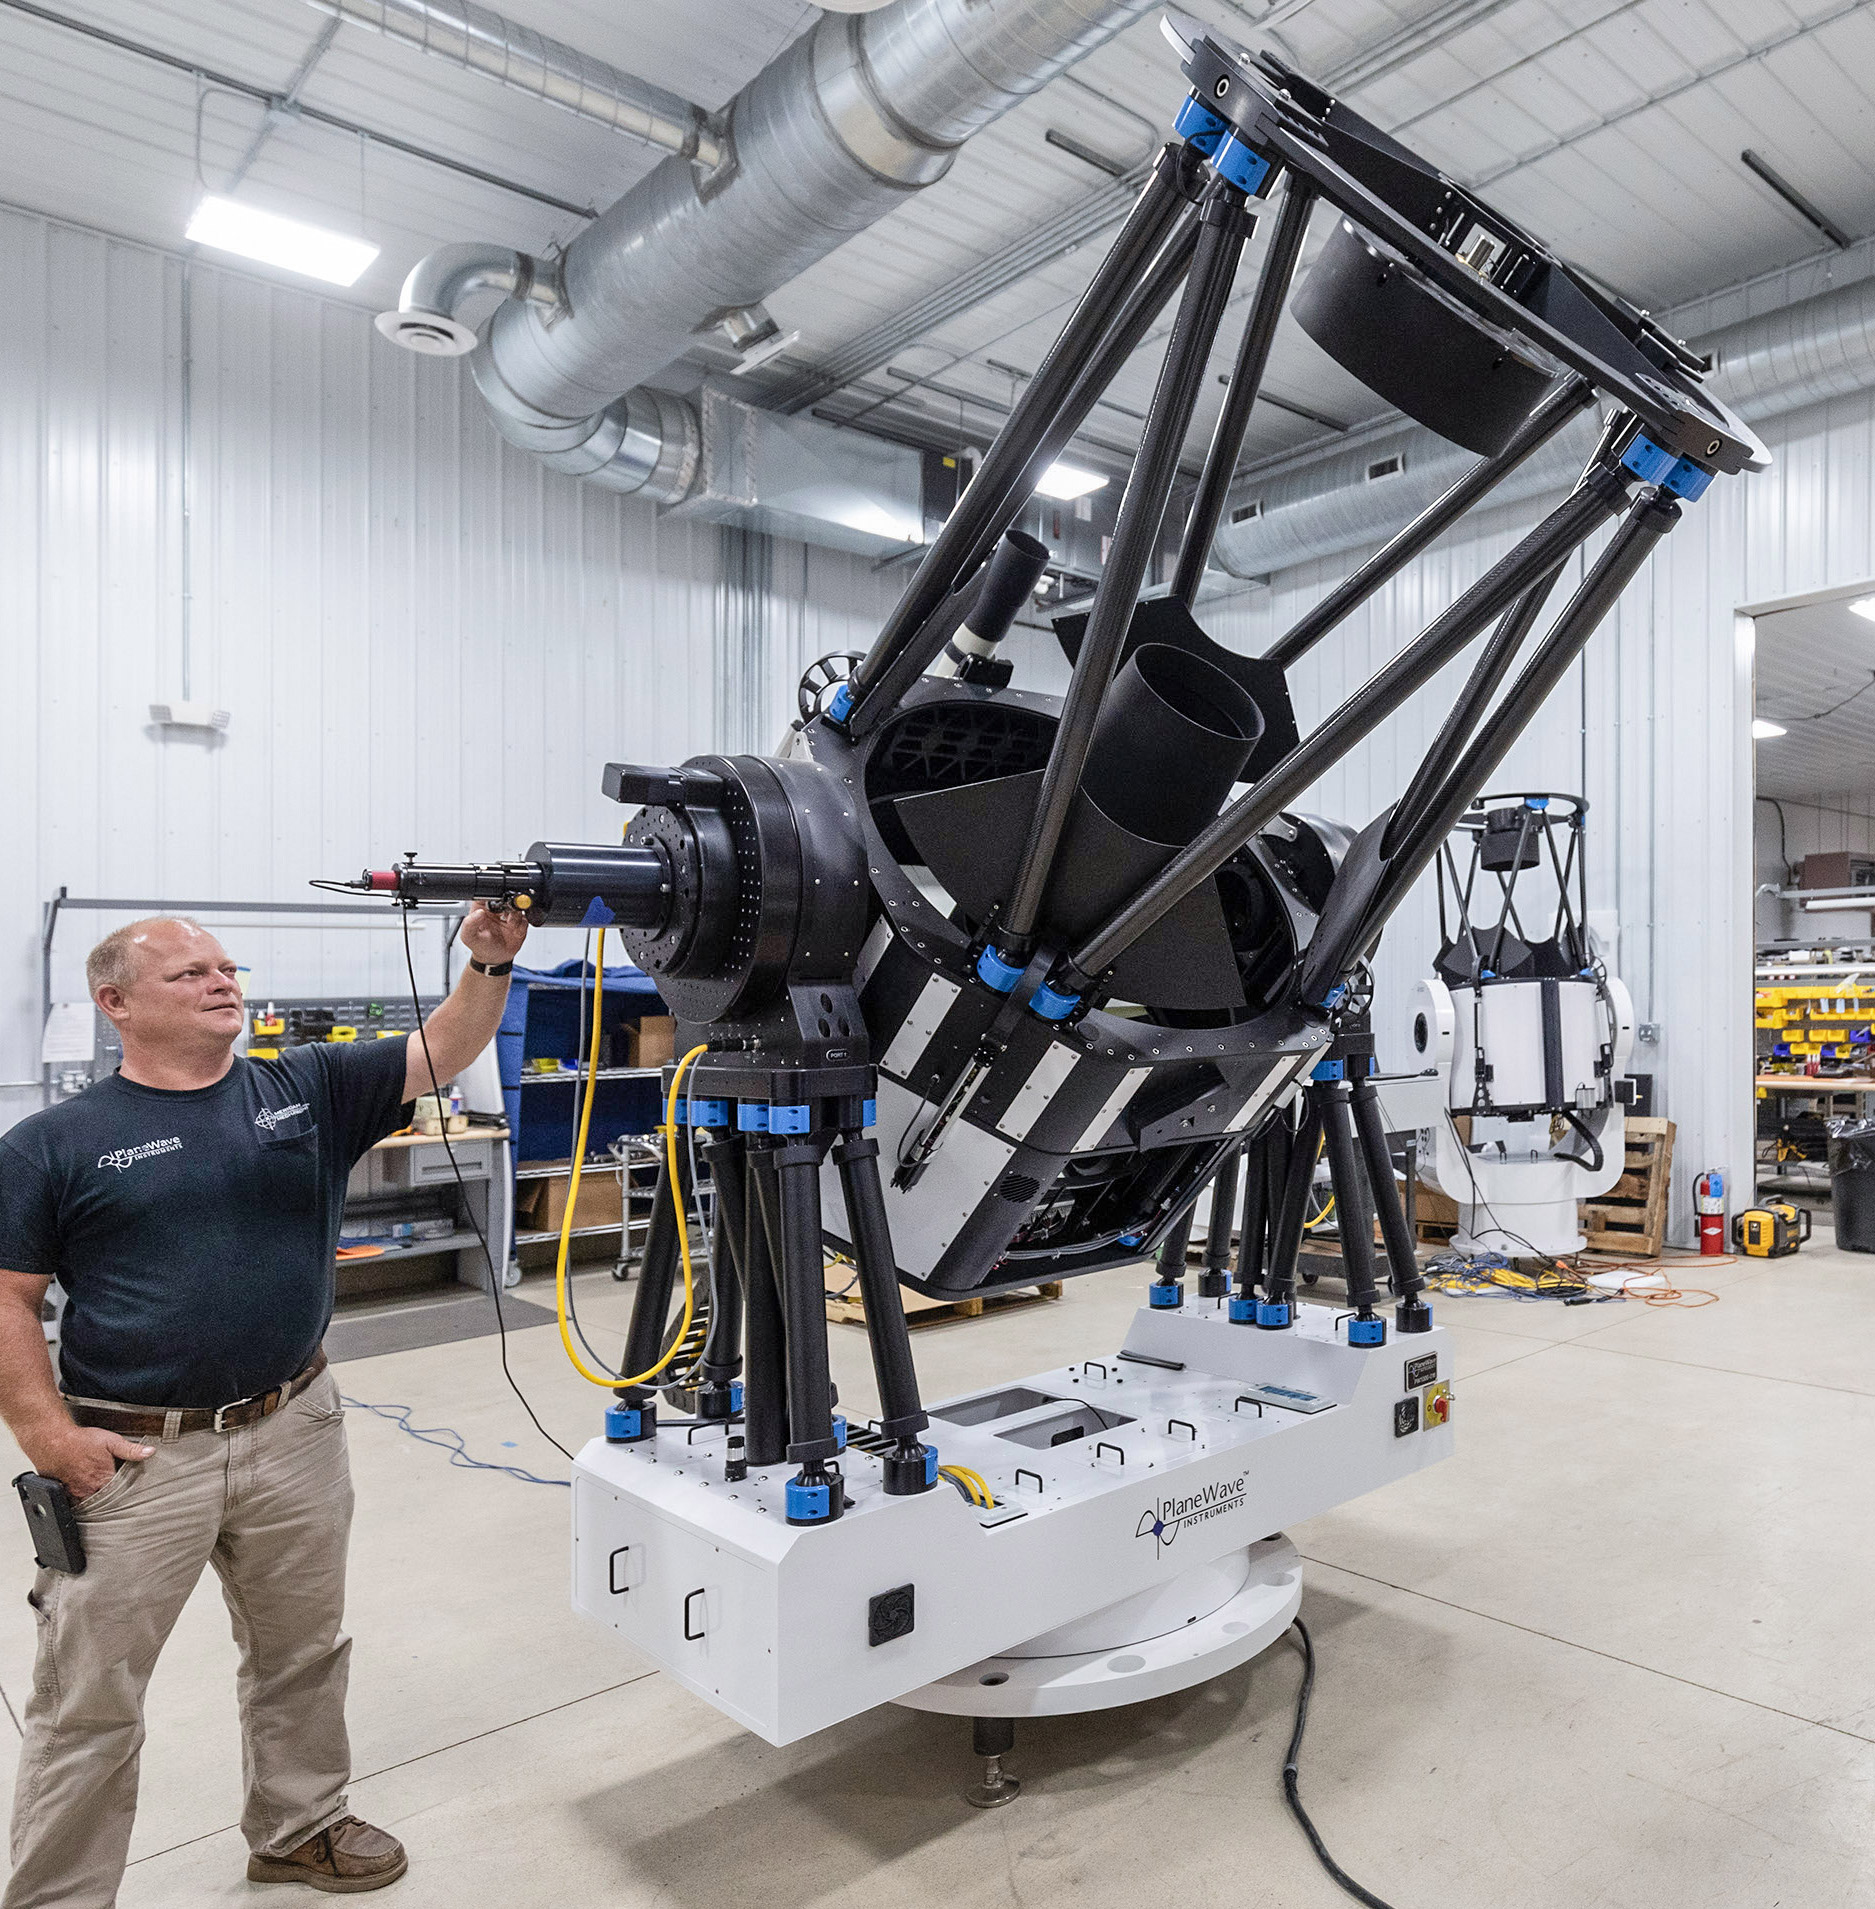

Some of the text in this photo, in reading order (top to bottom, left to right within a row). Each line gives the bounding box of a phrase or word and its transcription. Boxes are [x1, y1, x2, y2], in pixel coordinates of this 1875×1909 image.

[114, 1136, 181, 1159] PlaneWave
[134, 1143, 184, 1161] INSTRUMENTS
[1162, 1478, 1244, 1521] PlaneWave
[1183, 1498, 1244, 1528] INSTRUMENTS
